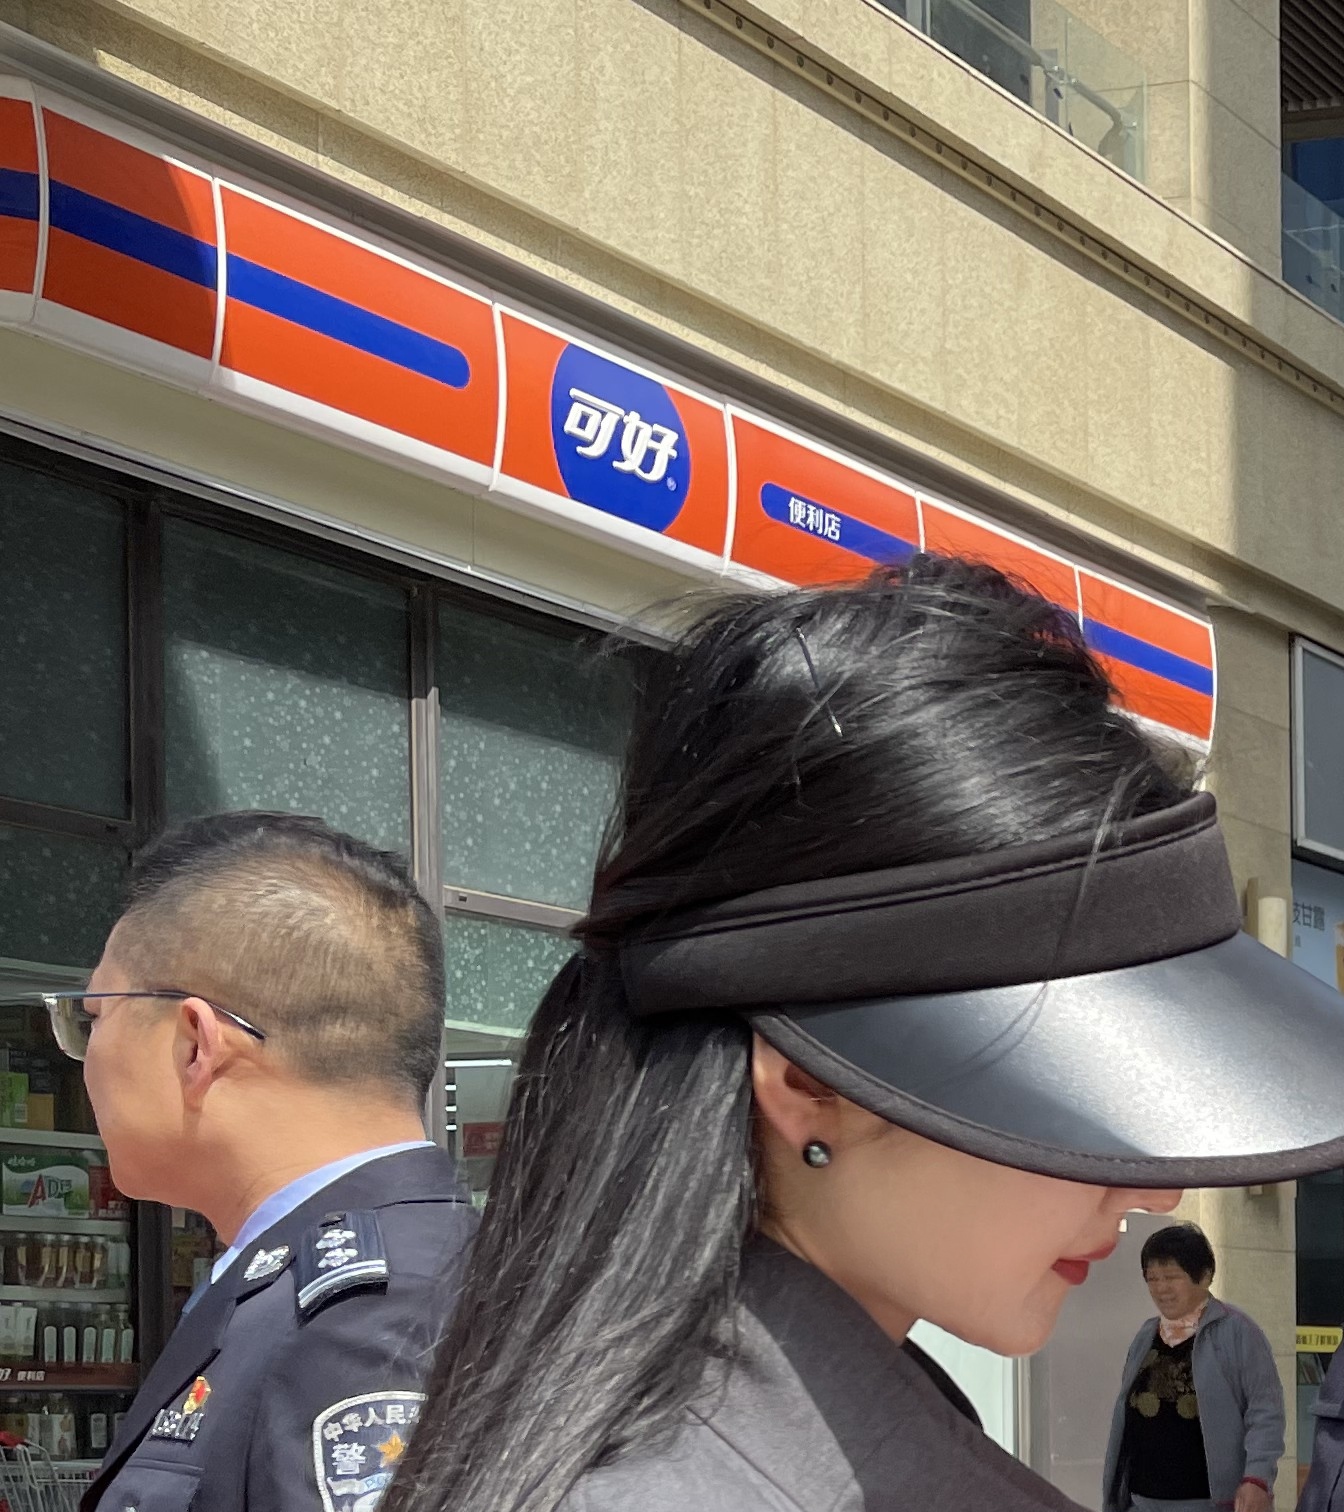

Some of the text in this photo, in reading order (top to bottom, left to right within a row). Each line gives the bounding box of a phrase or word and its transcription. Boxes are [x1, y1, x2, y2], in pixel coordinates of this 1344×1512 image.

[563, 387, 680, 484] 可好
[787, 496, 842, 541] 便利店
[331, 1442, 366, 1475] 警
